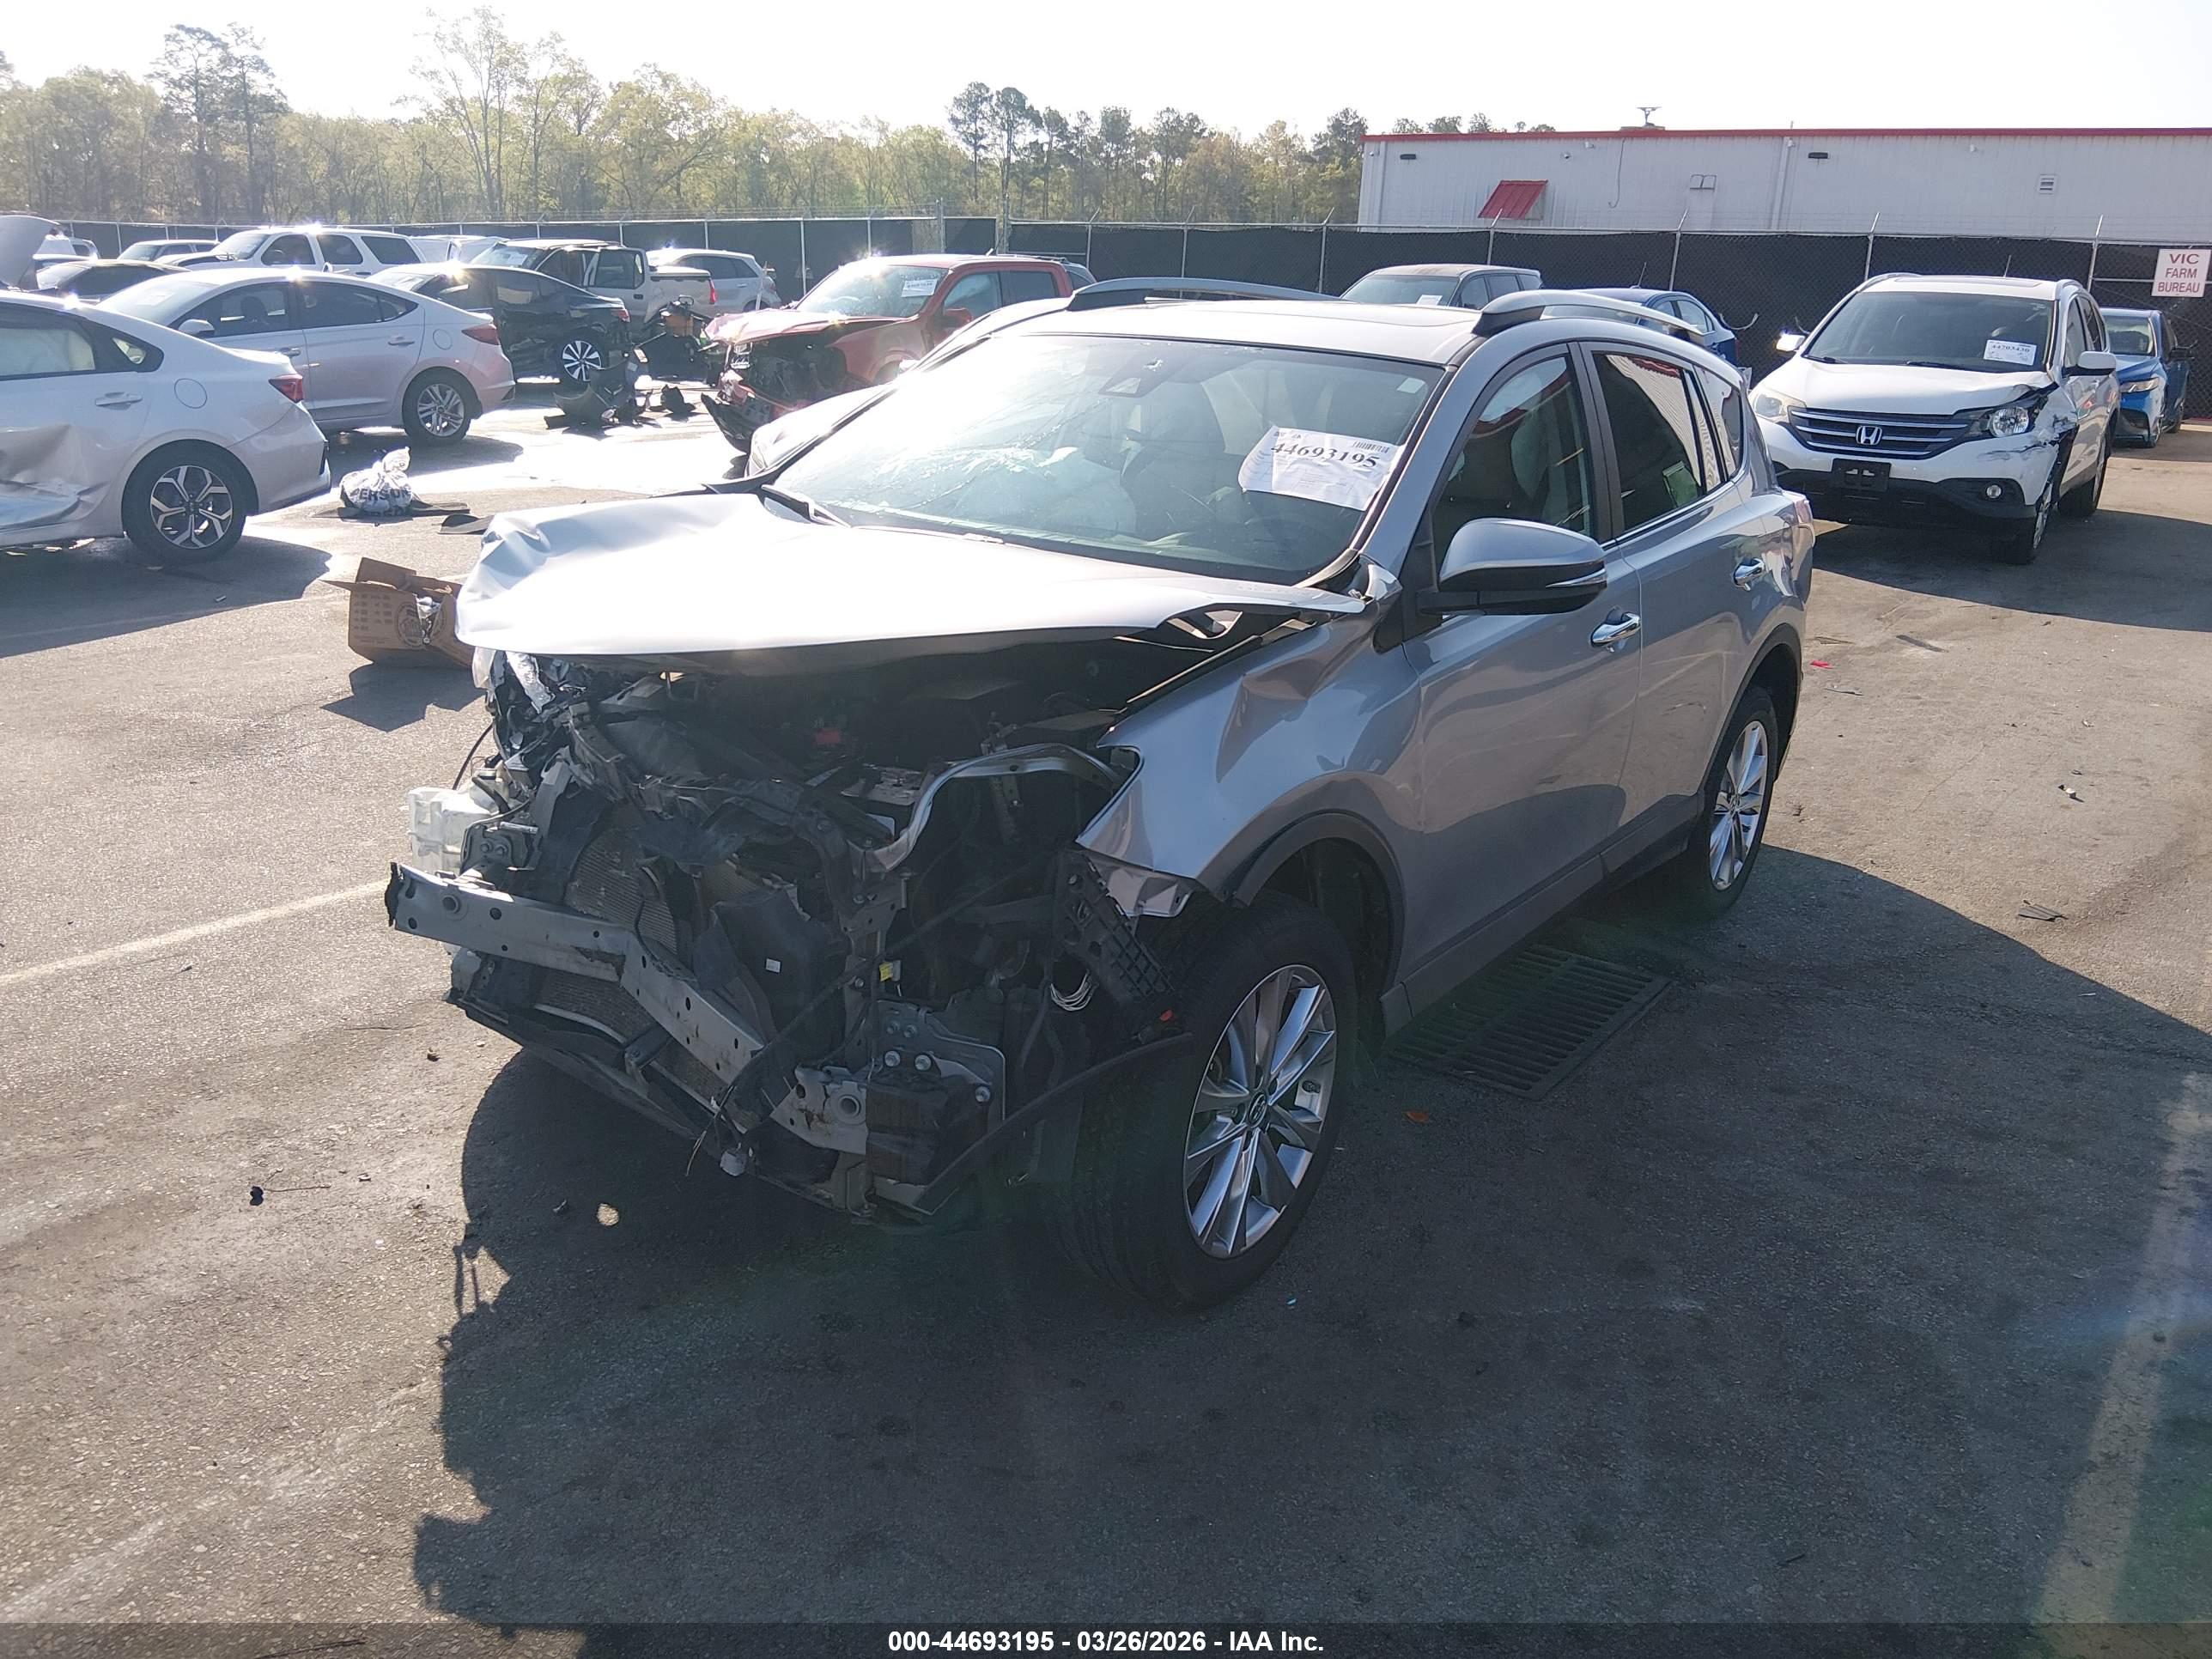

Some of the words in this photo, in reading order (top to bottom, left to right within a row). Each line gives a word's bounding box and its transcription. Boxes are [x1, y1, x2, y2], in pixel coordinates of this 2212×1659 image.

[2169, 253, 2200, 264] VIC
[2165, 267, 2197, 279] FARM
[2157, 282, 2200, 294] BUREAU
[1271, 442, 1381, 468] 44693195
